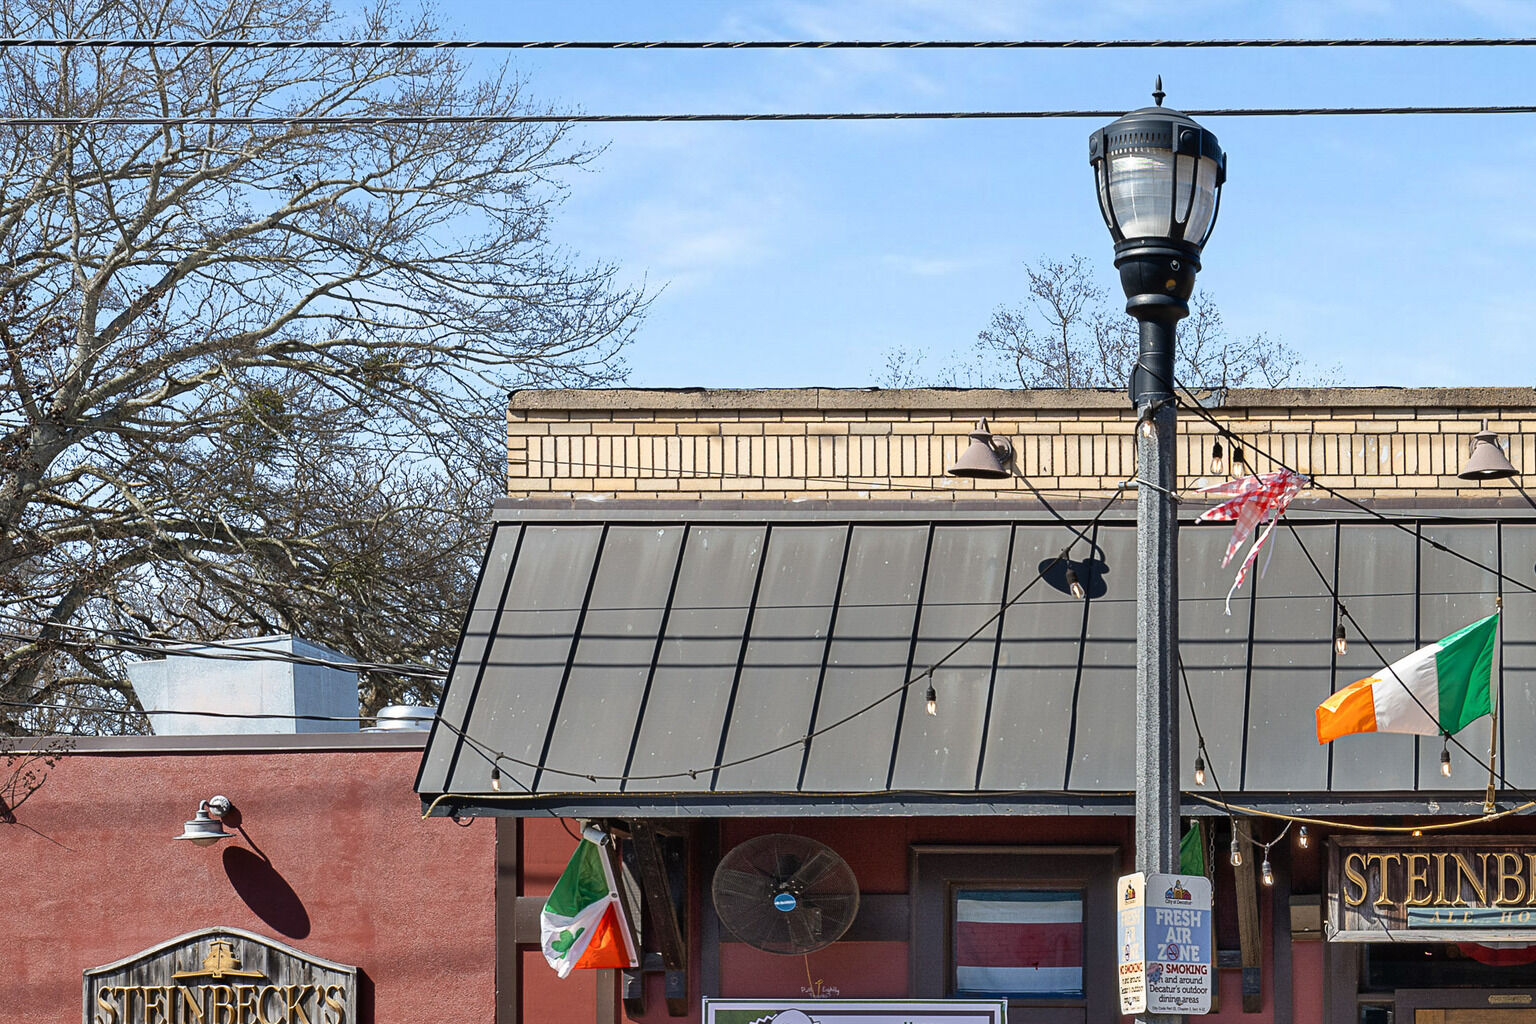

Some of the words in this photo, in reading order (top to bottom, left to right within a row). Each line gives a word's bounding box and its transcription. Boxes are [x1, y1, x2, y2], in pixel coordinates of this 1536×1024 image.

[1156, 909, 1201, 927] FRESH
[1429, 911, 1475, 924] ALE
[1166, 927, 1192, 944] AIR
[1166, 964, 1207, 974] SMOKING
[1150, 985, 1180, 993] Decatur's
[1159, 995, 1181, 1003] dining
